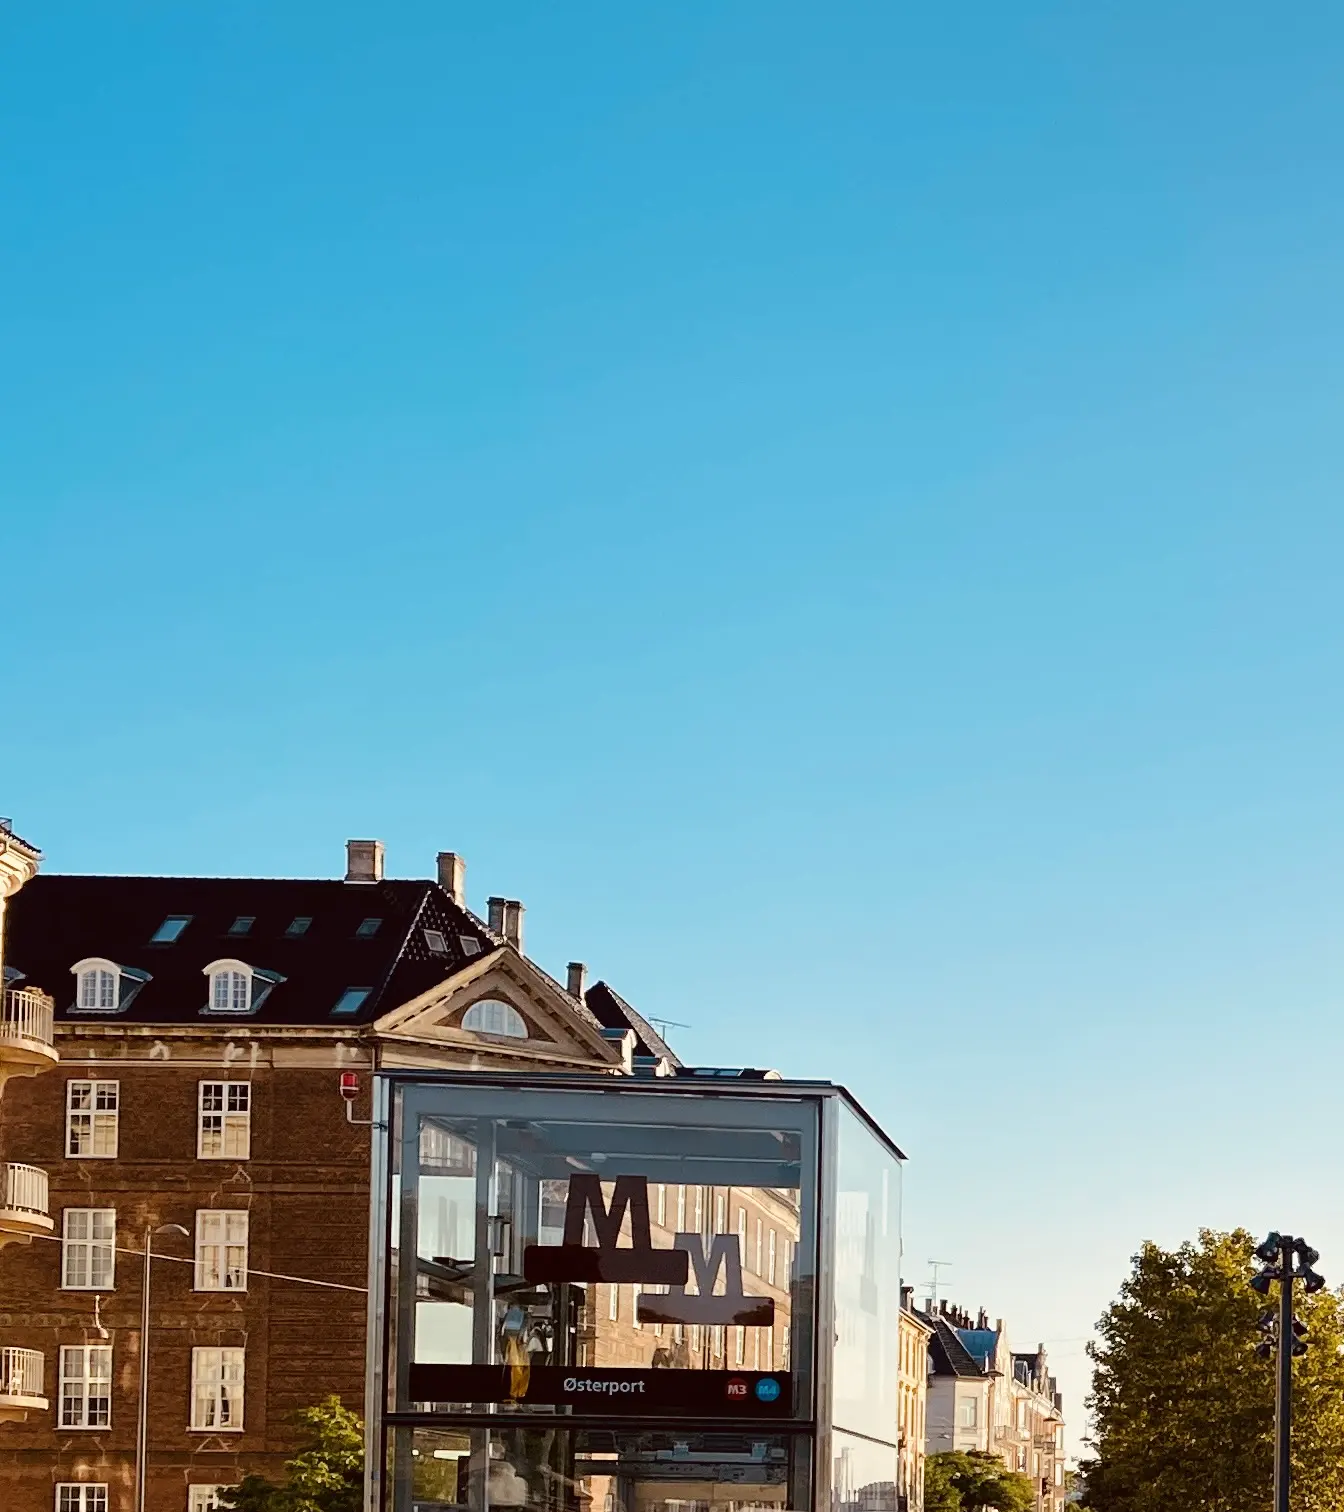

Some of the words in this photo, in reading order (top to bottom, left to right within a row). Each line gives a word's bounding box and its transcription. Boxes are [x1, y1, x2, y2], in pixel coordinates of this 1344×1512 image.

[562, 1173, 652, 1249] M
[669, 1232, 743, 1296] M
[563, 1377, 646, 1396] Østerport
[727, 1384, 748, 1395] M3
[758, 1384, 777, 1395] M4
